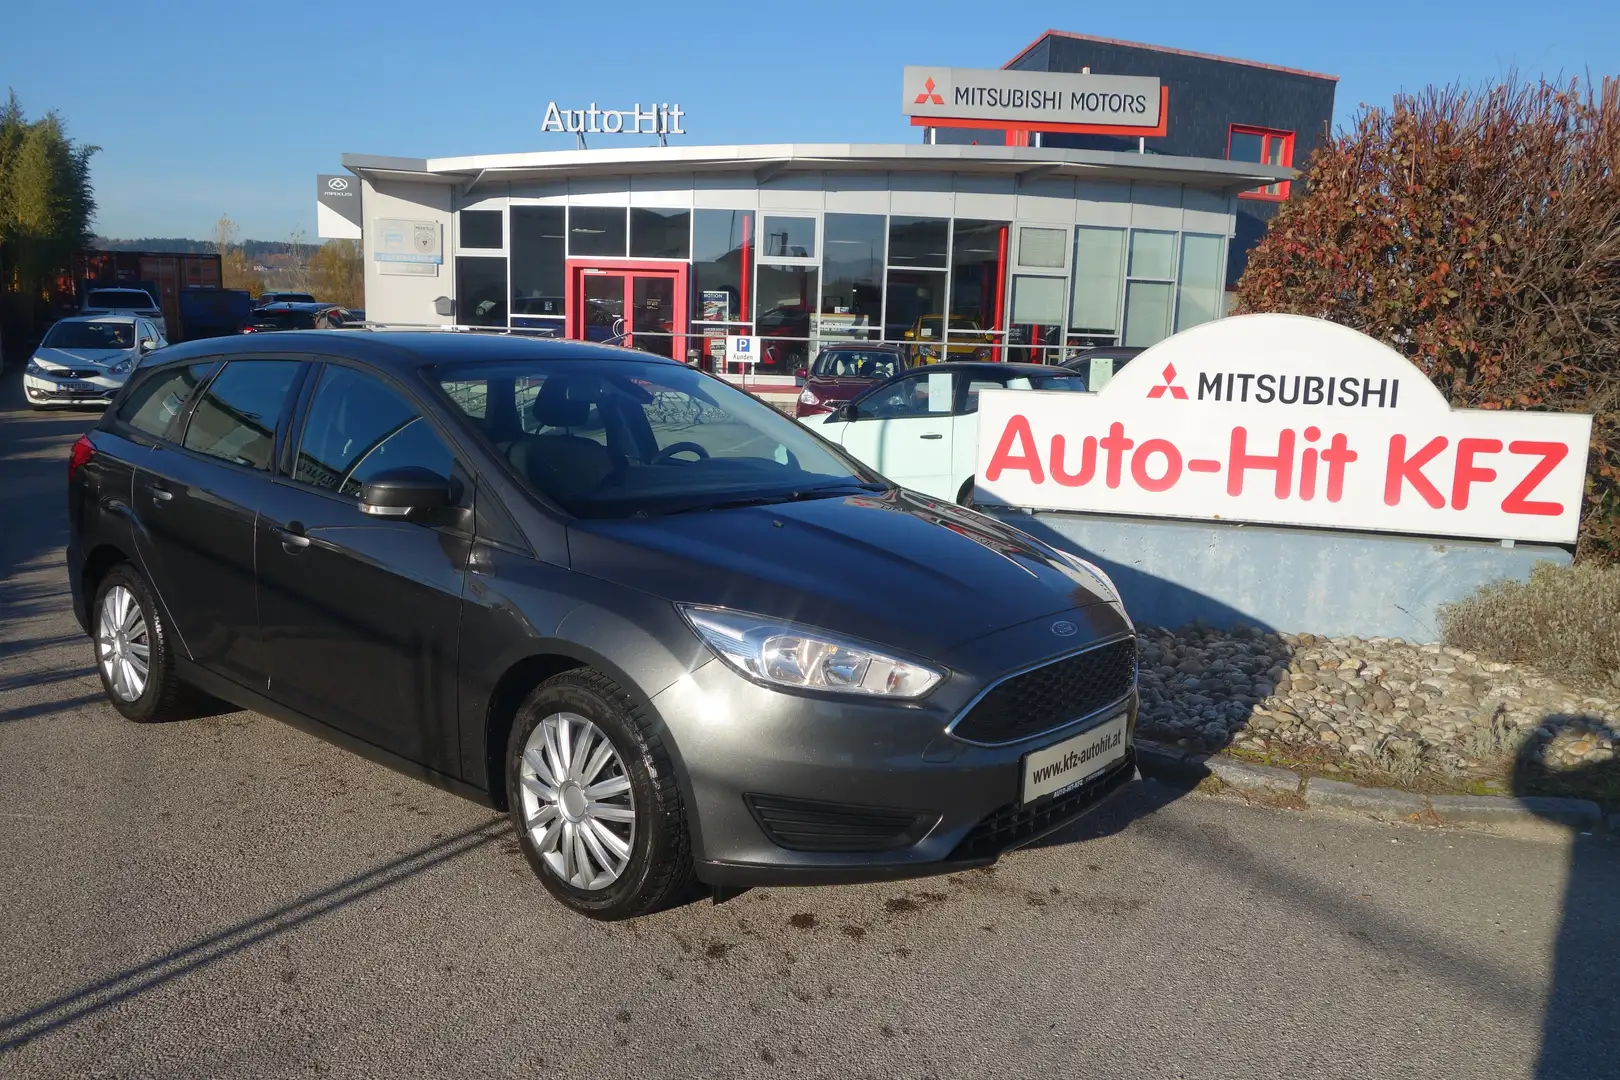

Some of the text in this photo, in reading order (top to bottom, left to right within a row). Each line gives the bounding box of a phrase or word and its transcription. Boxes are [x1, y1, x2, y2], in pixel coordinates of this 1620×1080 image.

[541, 101, 686, 134] Auto Hit
[954, 87, 1147, 114] MITSUBISHI MOTORS
[1197, 372, 1399, 408] MITSUBISHI
[986, 414, 1569, 516] Auto-Hit KFZ
[1033, 728, 1121, 784] www.kfz-autohit.at
